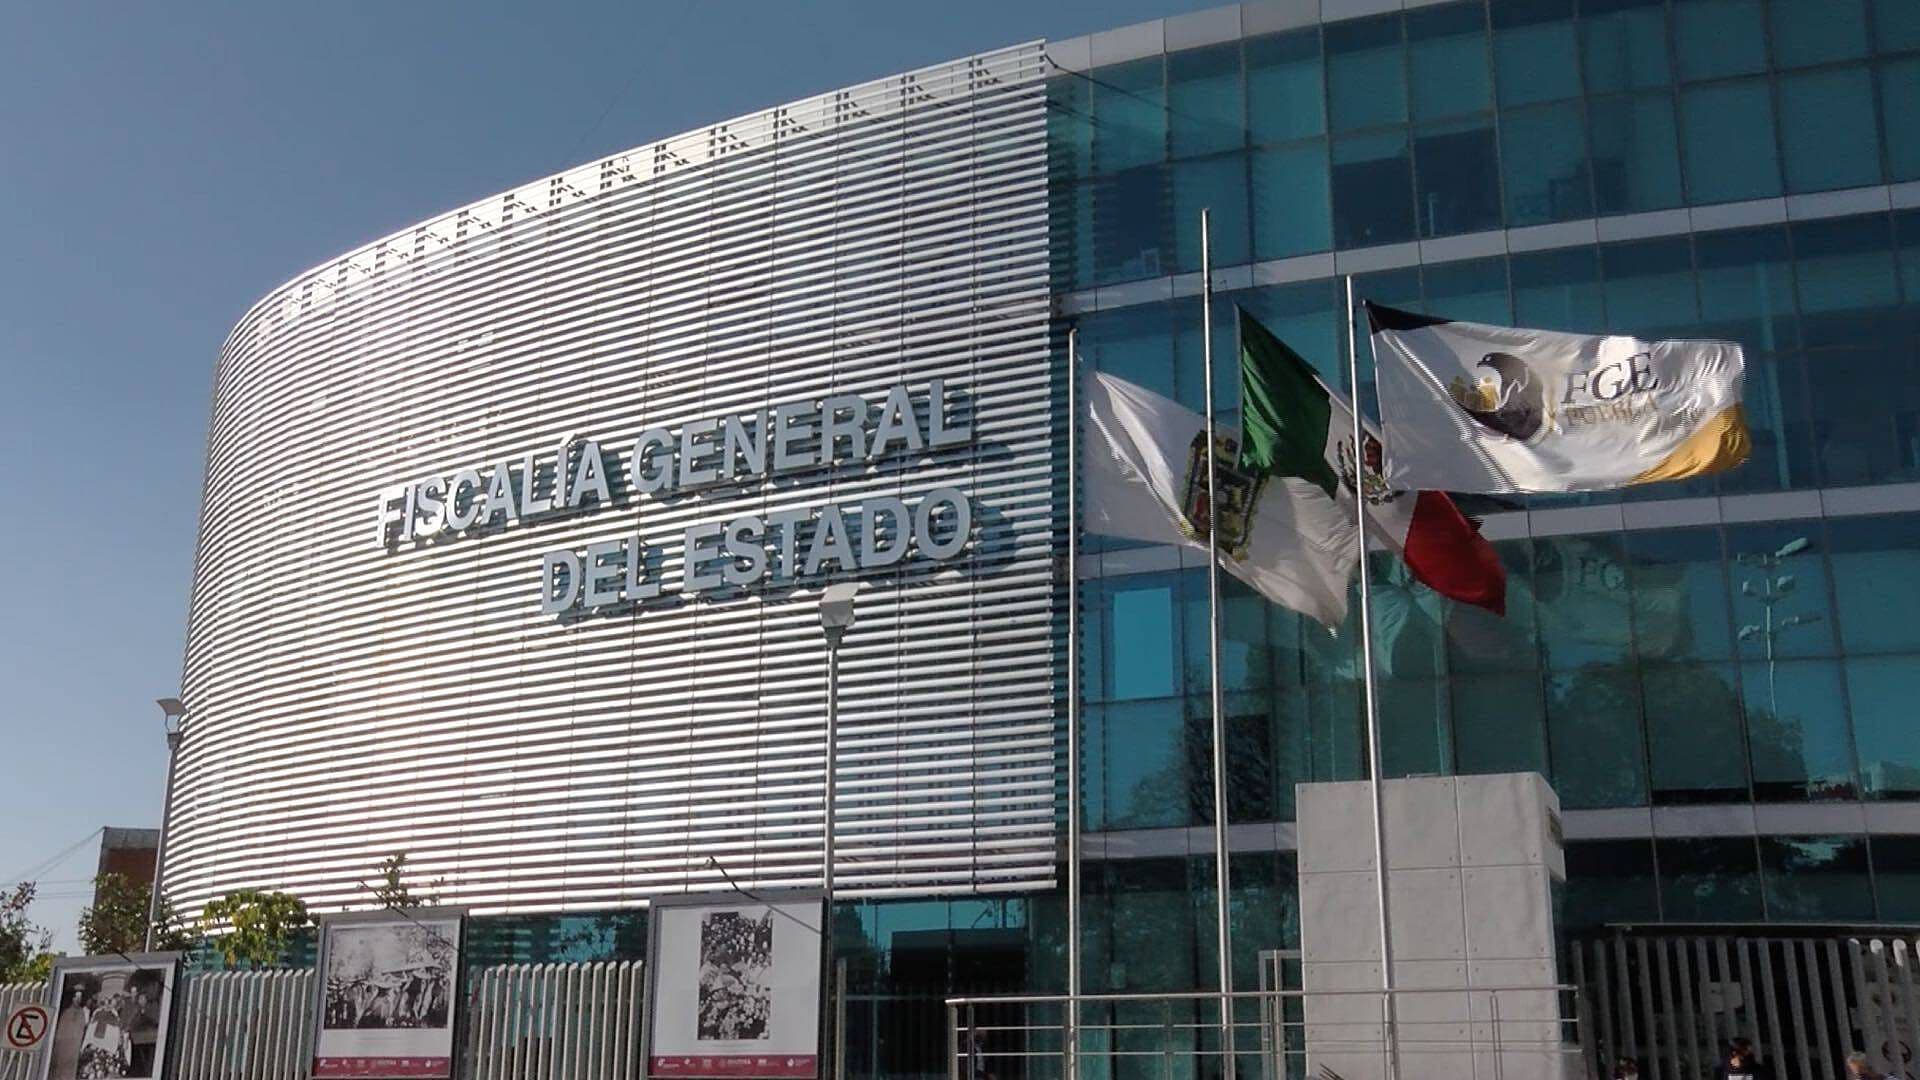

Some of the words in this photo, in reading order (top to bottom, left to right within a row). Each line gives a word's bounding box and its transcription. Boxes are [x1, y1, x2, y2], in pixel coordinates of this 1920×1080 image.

[1560, 352, 1659, 404] FGE
[375, 437, 612, 549] FISCALÍA
[632, 379, 972, 492] GENERAL
[541, 537, 661, 613] DEL
[683, 487, 972, 592] ESTADO
